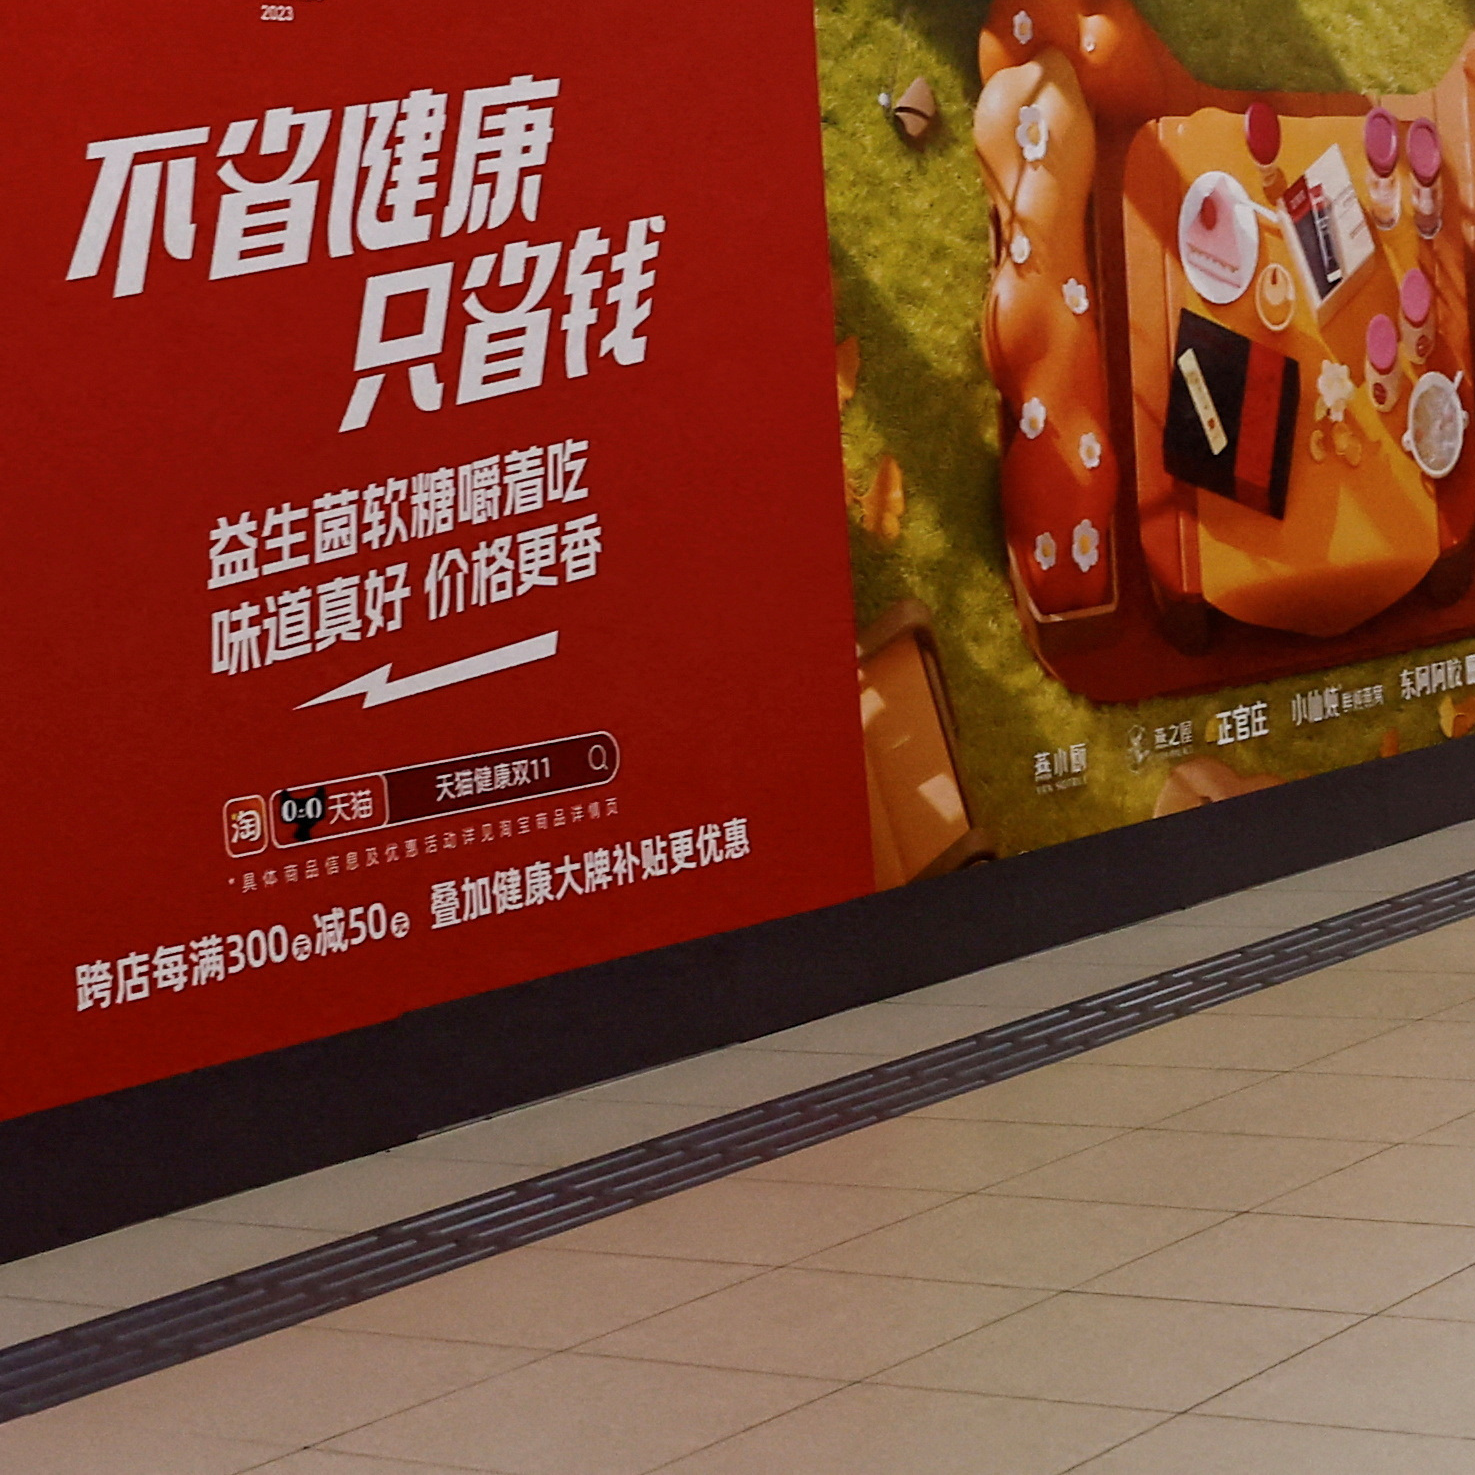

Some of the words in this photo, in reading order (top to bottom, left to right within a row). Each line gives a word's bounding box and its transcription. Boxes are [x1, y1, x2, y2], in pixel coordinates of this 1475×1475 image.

[260, 4, 294, 22] 2023
[65, 74, 561, 298] 不省健康
[338, 215, 666, 433] 只省钱
[207, 438, 589, 590] 益生菌软糖嚼着吃
[211, 562, 411, 676] 味道真好
[424, 513, 602, 621] 价格更香
[1215, 701, 1270, 746] 正官庄
[231, 810, 262, 844] 淘
[327, 789, 373, 825] 天猫
[435, 757, 550, 802] 天猫健康双11
[430, 817, 750, 930] 叠加健康大牌补贴更优惠
